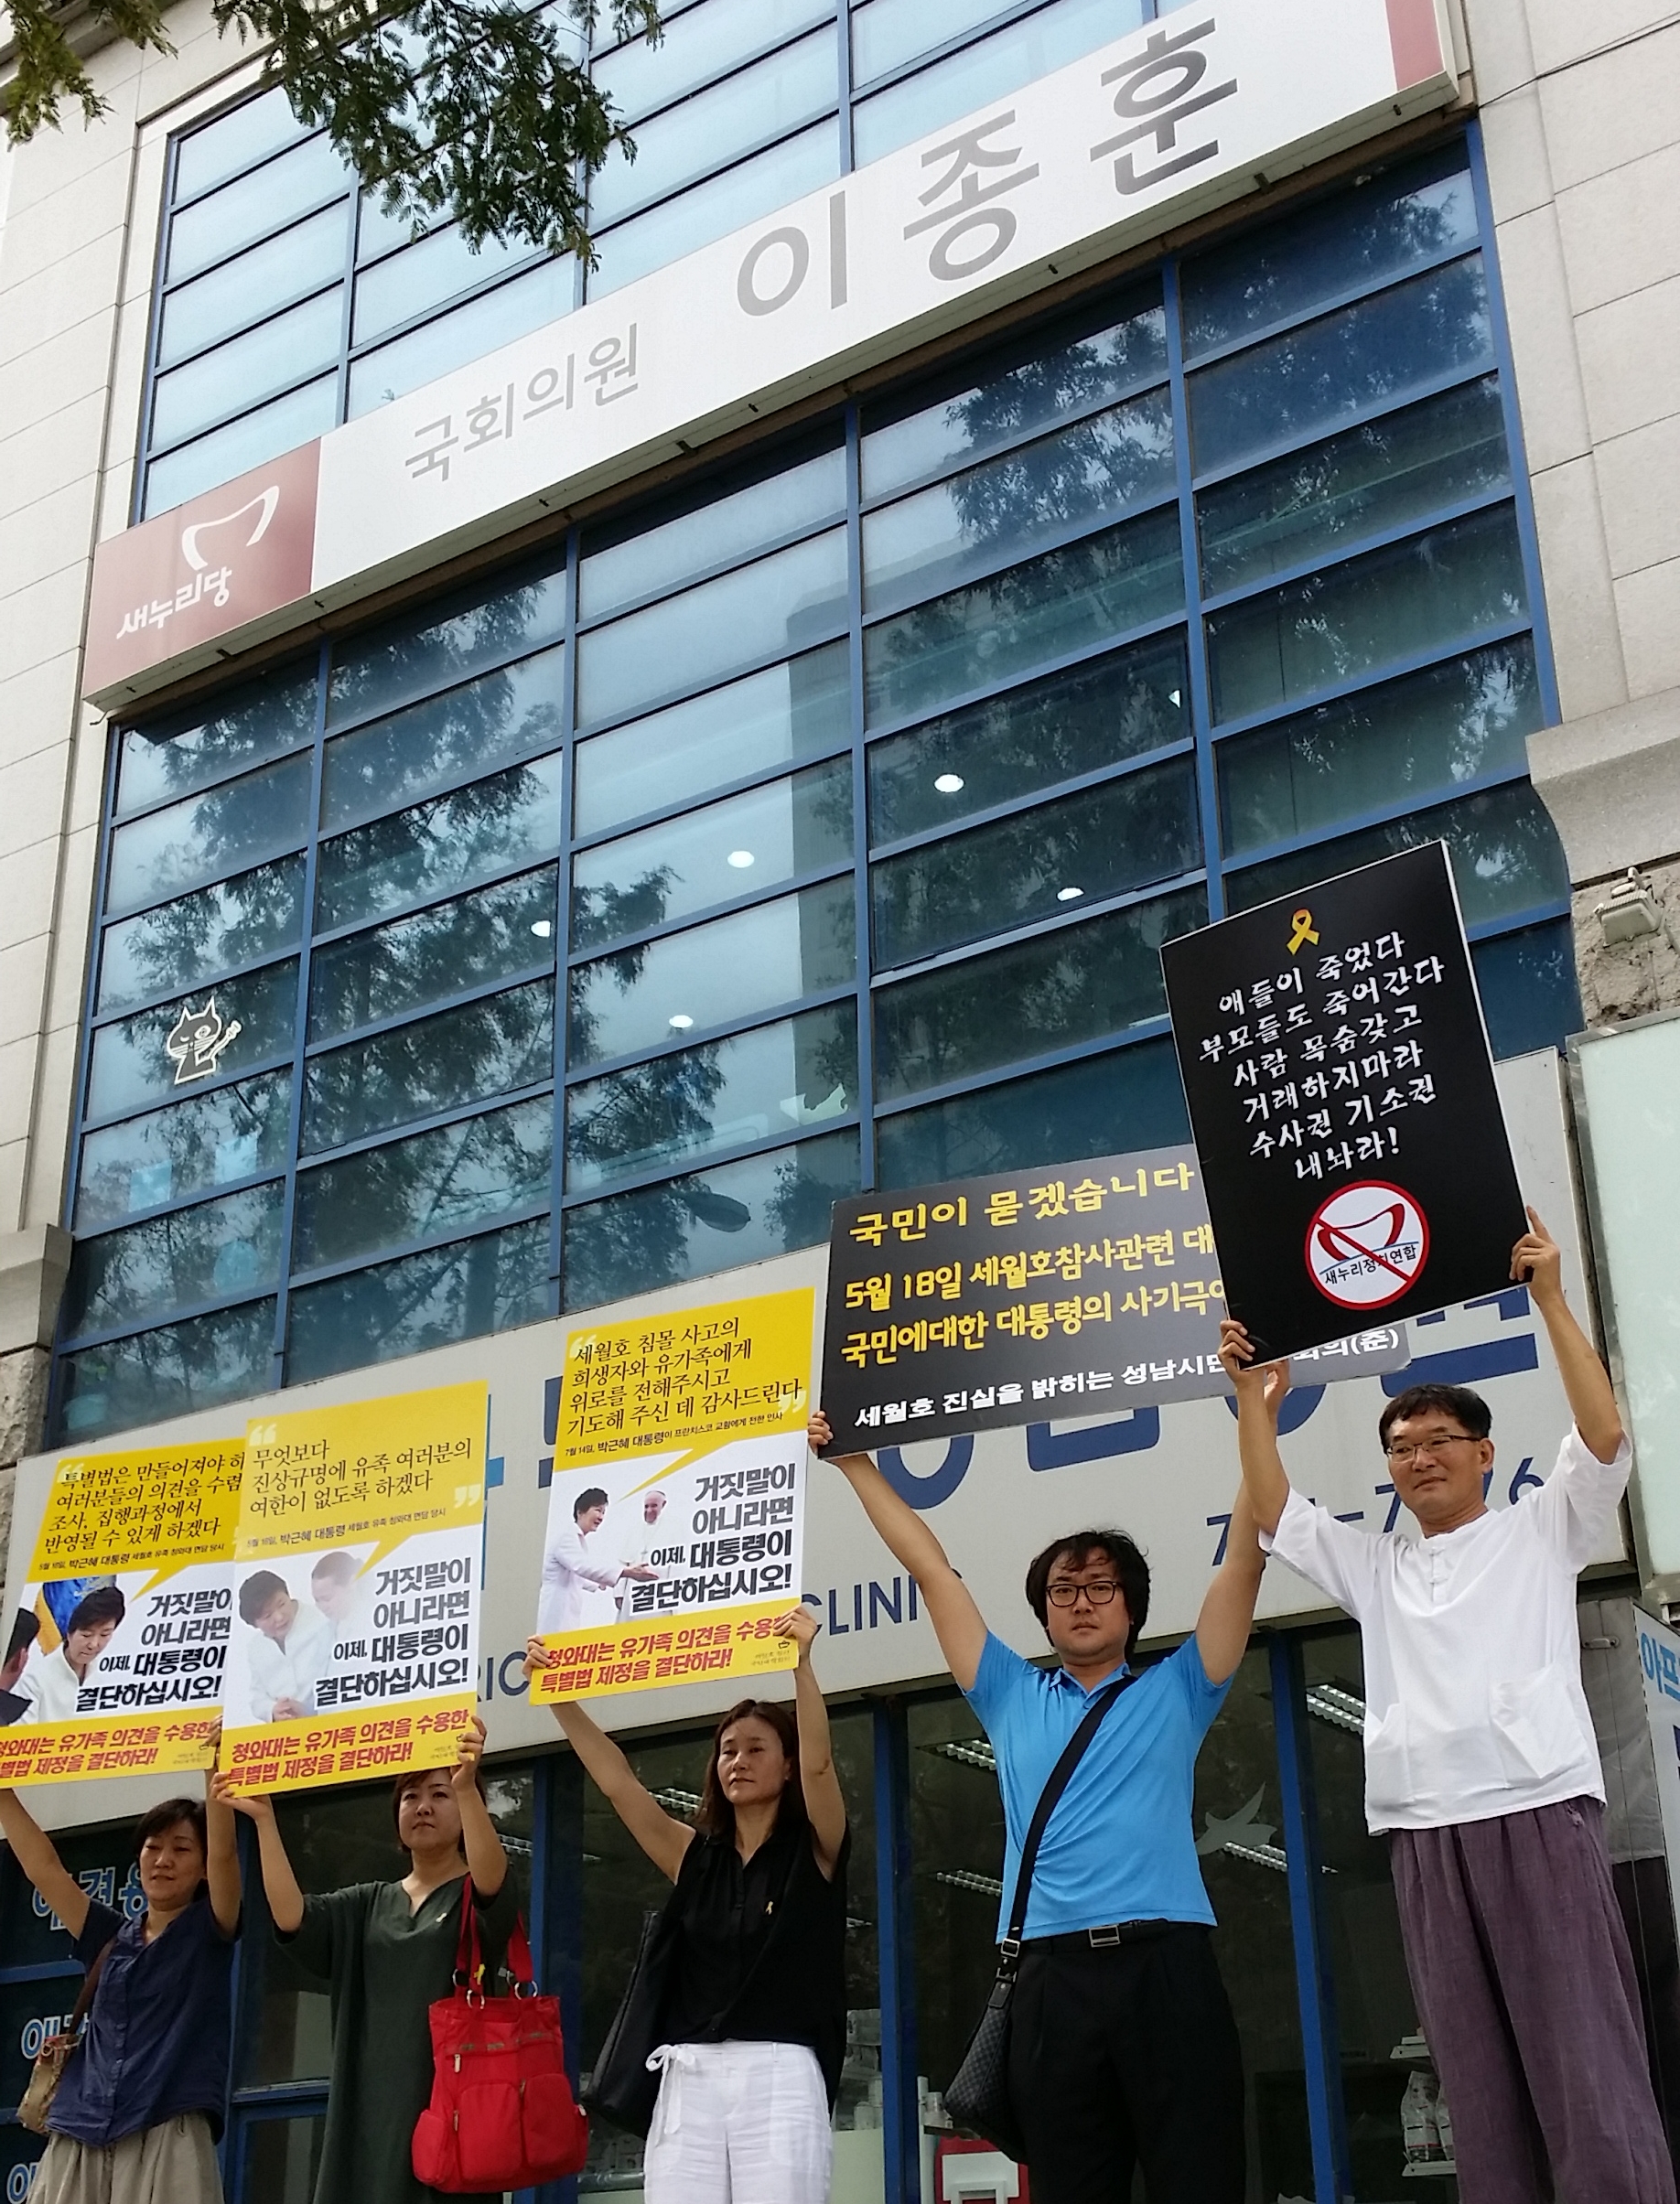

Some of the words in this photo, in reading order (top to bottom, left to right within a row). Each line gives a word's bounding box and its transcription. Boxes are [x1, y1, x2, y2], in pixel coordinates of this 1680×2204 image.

[404, 323, 640, 482] 국회의원
[116, 566, 232, 640] 새누리당
[1219, 967, 1304, 1016] 애들이
[1316, 930, 1406, 981] 죽었다
[1199, 1003, 1313, 1063] 부모들도
[1322, 955, 1446, 1016] 죽어간다
[1233, 1048, 1288, 1089] 사람
[1299, 1005, 1424, 1062] 목숨갖고
[1243, 1040, 1424, 1124] 거래하지마라
[1249, 1109, 1333, 1159] 수사권
[1345, 1074, 1438, 1127] 기소권
[1294, 1126, 1400, 1180] 내놔라!
[848, 1196, 968, 1247] 국민이
[984, 1162, 1195, 1228] 묻겠습니다
[845, 1273, 892, 1311] 5월
[902, 1262, 962, 1301] 18일
[969, 1230, 1175, 1290] 세월호참사관련
[574, 1338, 631, 1364] 세월호
[638, 1329, 675, 1355] 침몰
[681, 1317, 740, 1345] 사고의
[841, 1310, 990, 1370] 국민에대한
[996, 1291, 1113, 1341] 대통령의
[572, 1360, 649, 1389] 희생자와
[654, 1339, 752, 1374] 유가족에게
[568, 1409, 624, 1437] 기도해
[630, 1403, 669, 1427] 주신
[676, 1397, 695, 1420] 데
[701, 1378, 802, 1413] 감사드린다
[570, 1386, 627, 1414] 위로를
[633, 1368, 730, 1402] 전해주시고
[855, 1397, 936, 1428] 세월호
[942, 1384, 1024, 1414] 진실을
[1031, 1369, 1114, 1398] 밝히는
[253, 1439, 330, 1470] 무엇보다
[598, 1438, 630, 1453] 박근혜
[632, 1430, 673, 1447] 대통령이
[674, 1425, 713, 1437] 프란치스코
[715, 1419, 748, 1431] 교황에게
[767, 1412, 783, 1422] 인사
[61, 1466, 131, 1489] 특별법은
[137, 1454, 225, 1482] 만들어져야
[253, 1459, 347, 1493] 진상규명에
[352, 1454, 391, 1478] 유족
[396, 1437, 471, 1468] 여러분의
[695, 1462, 796, 1502] 거짓말이
[56, 1485, 144, 1511] 여러분들의
[148, 1477, 202, 1501] 의견을
[96, 1499, 203, 1529] 집행과정에서
[250, 1491, 306, 1518] 여한이
[314, 1482, 370, 1510] 없도록
[376, 1469, 434, 1499] 하겠다
[693, 1496, 793, 1536] 아니라면
[44, 1531, 98, 1554] 반영될
[102, 1529, 120, 1548] 수
[125, 1523, 162, 1545] 있게
[167, 1517, 221, 1542] 하겠다
[280, 1531, 312, 1544] 박근혜
[315, 1525, 346, 1539] 대통령
[690, 1529, 792, 1569] 대통령이
[69, 1556, 98, 1569] 박근혜
[101, 1553, 130, 1565] 대통령
[375, 1557, 471, 1597] 거짓말이
[373, 1591, 469, 1629] 아니라면
[631, 1564, 792, 1613] 결단하십시오!
[141, 1616, 231, 1647] 아니라면
[372, 1624, 468, 1663] 대통령이
[619, 1632, 673, 1657] 유가족
[676, 1623, 731, 1649] 의견을
[134, 1645, 228, 1676] 대통령이
[316, 1658, 468, 1707] 결단하십시오!
[541, 1670, 593, 1693] 특별법
[596, 1660, 652, 1686] 제정을
[655, 1648, 734, 1676] 결단하라!
[76, 1675, 222, 1713] 결단하십시오!
[58, 1731, 108, 1752] 유가족
[111, 1726, 161, 1747] 의견을
[232, 1736, 300, 1764] 청와대는
[305, 1726, 357, 1750] 유가족
[360, 1717, 412, 1743] 의견을
[416, 1709, 469, 1736] 수용한
[0, 1761, 31, 1779] 별법
[33, 1755, 84, 1775] 제정을
[88, 1747, 159, 1770] 결단하라!
[229, 1763, 278, 1788] 특별법
[282, 1754, 335, 1779] 제정을
[339, 1742, 413, 1770] 결단하라!
